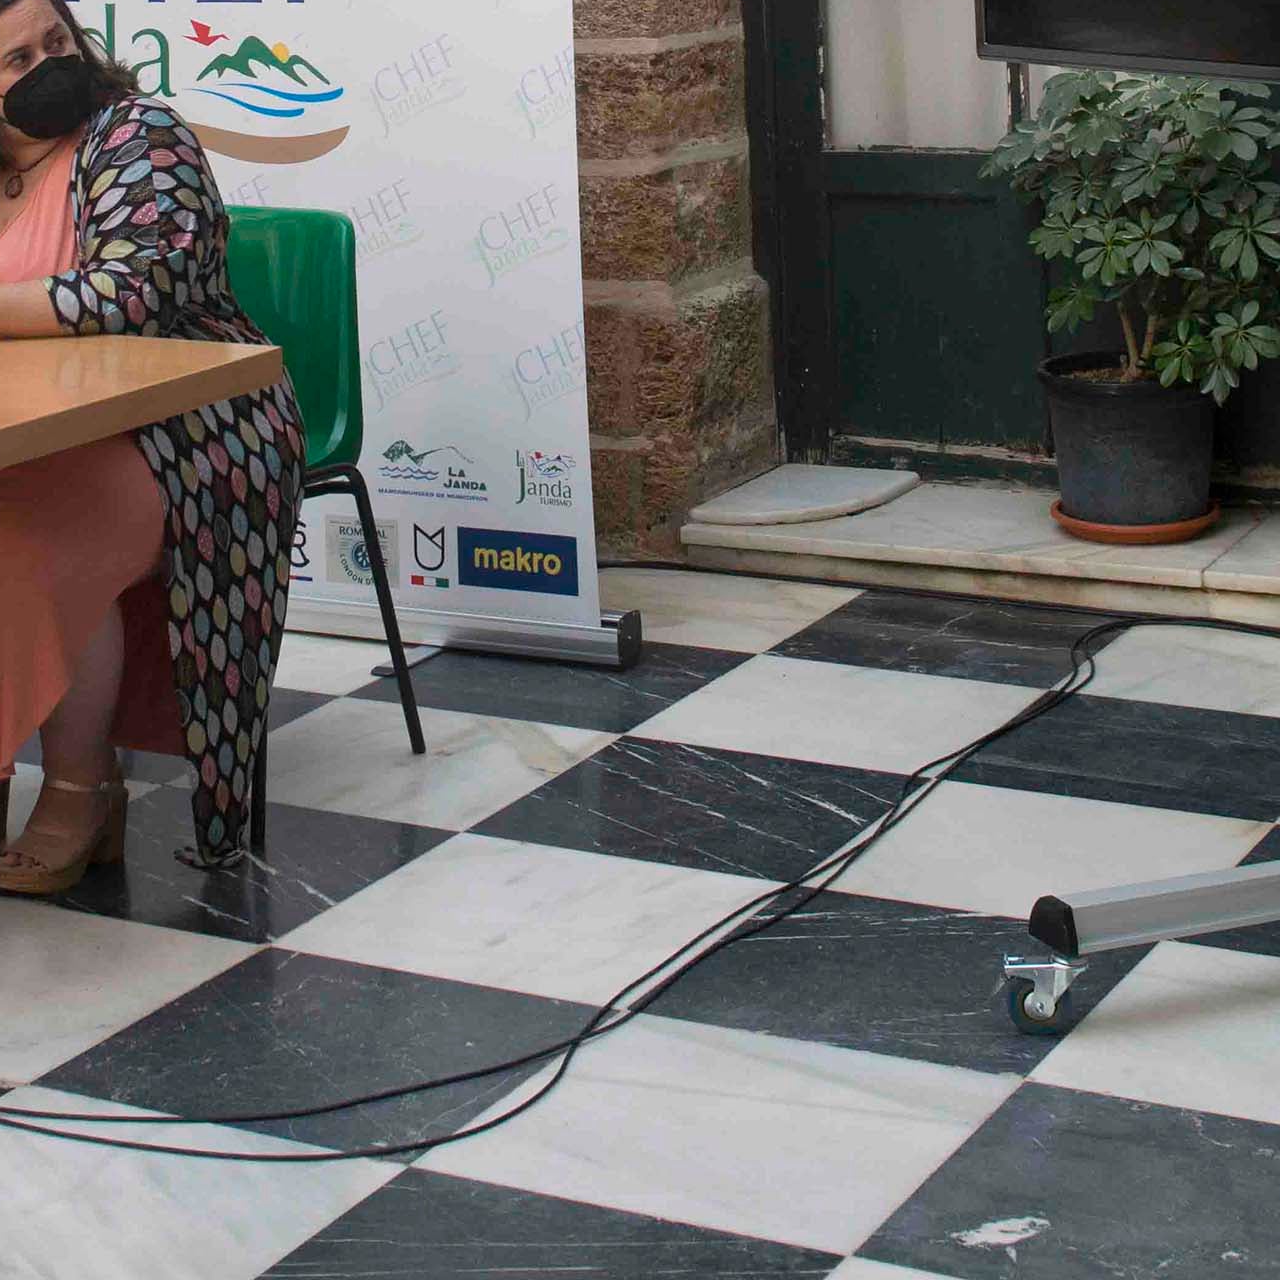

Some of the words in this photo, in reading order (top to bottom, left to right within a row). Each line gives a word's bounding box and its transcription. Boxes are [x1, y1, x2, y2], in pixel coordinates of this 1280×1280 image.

[447, 466, 466, 478] LA
[443, 479, 488, 492] JANDA
[515, 467, 572, 505] Janda
[473, 546, 562, 577] makro
